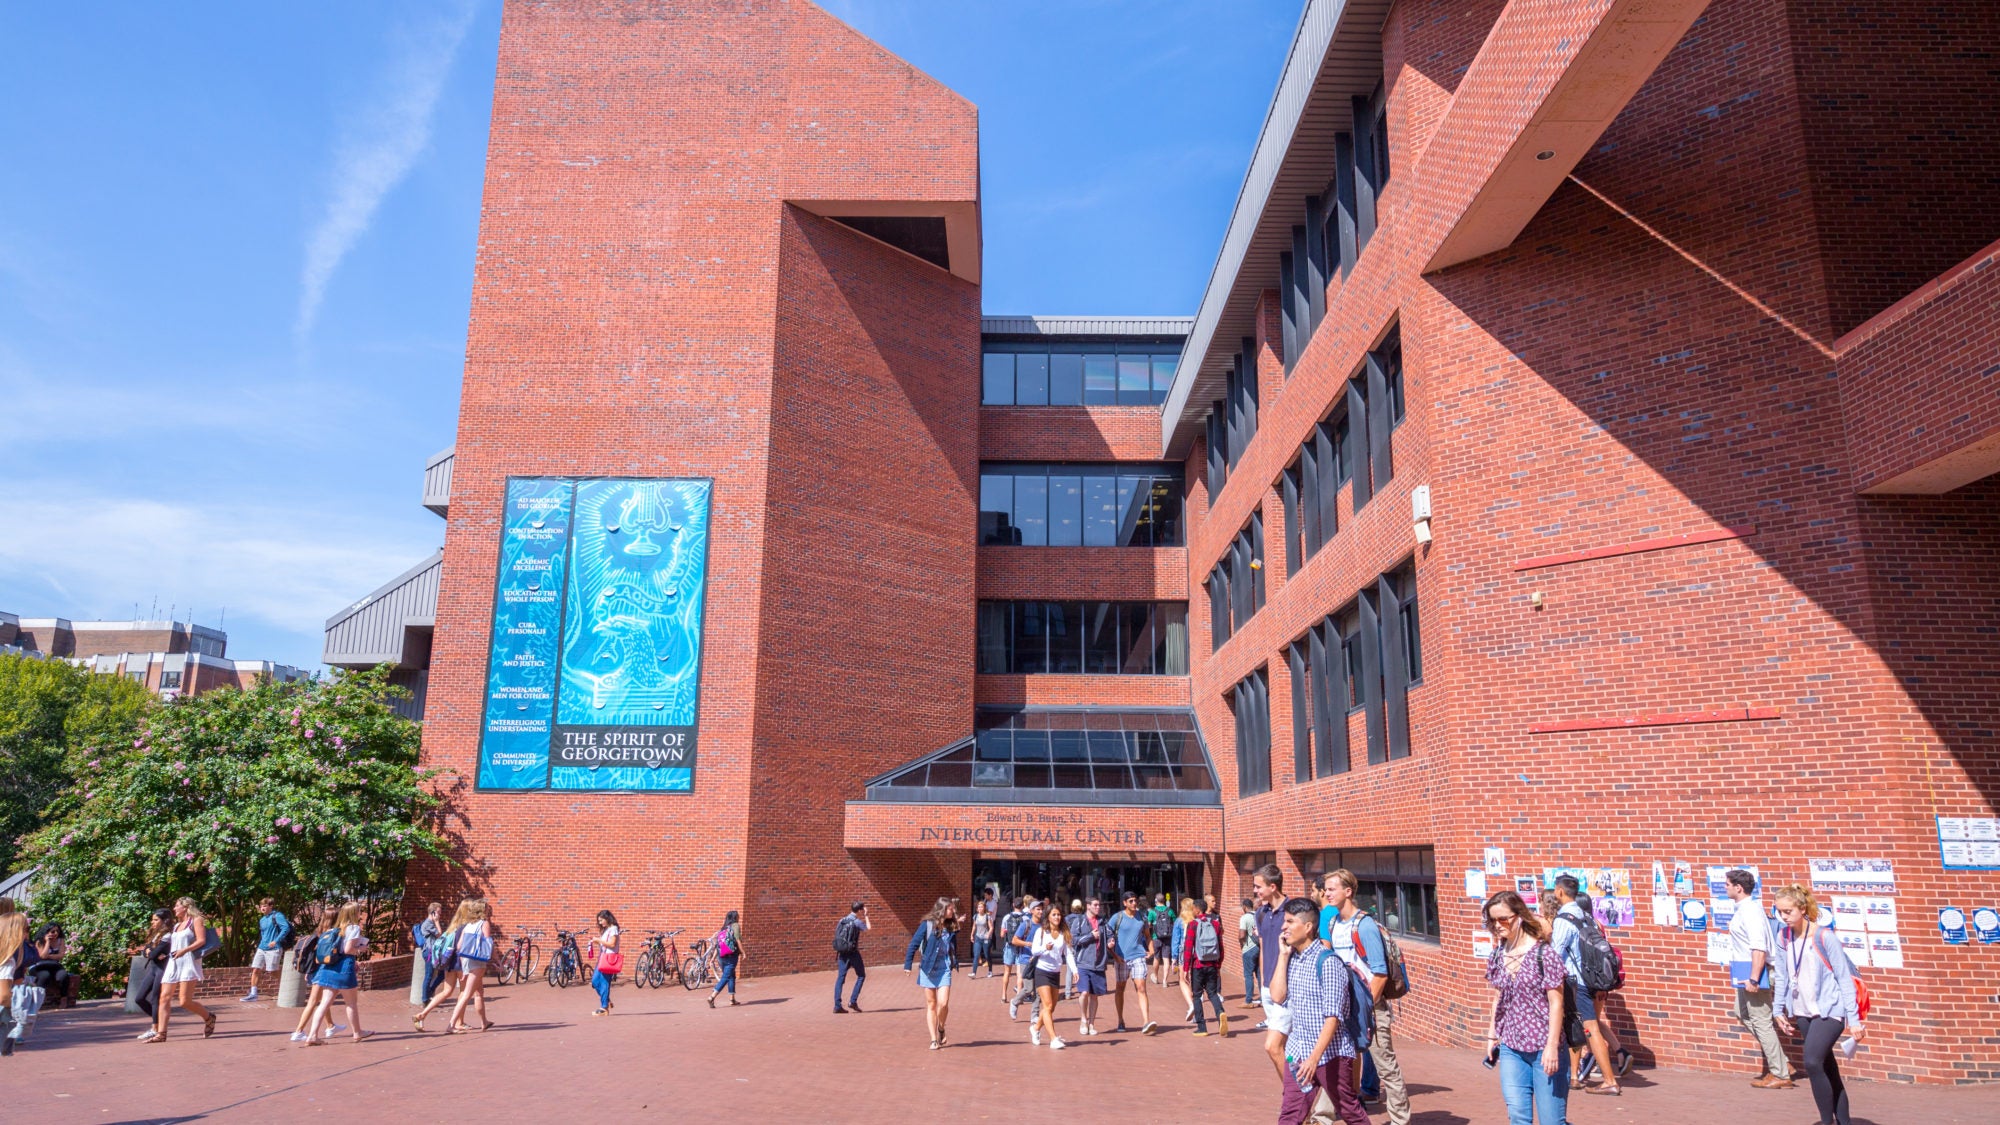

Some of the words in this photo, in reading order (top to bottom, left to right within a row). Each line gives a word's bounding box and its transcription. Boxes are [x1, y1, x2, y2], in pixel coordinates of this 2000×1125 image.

[563, 732, 597, 746] THE
[603, 733, 657, 746] SPIRIT
[662, 733, 686, 747] OF
[561, 747, 684, 761] GEORGETOWN
[987, 813, 1022, 822] Edward
[1038, 813, 1066, 823] Bunn,
[920, 828, 1065, 842] INTERCULTURAL
[1075, 829, 1145, 844] CENTER
